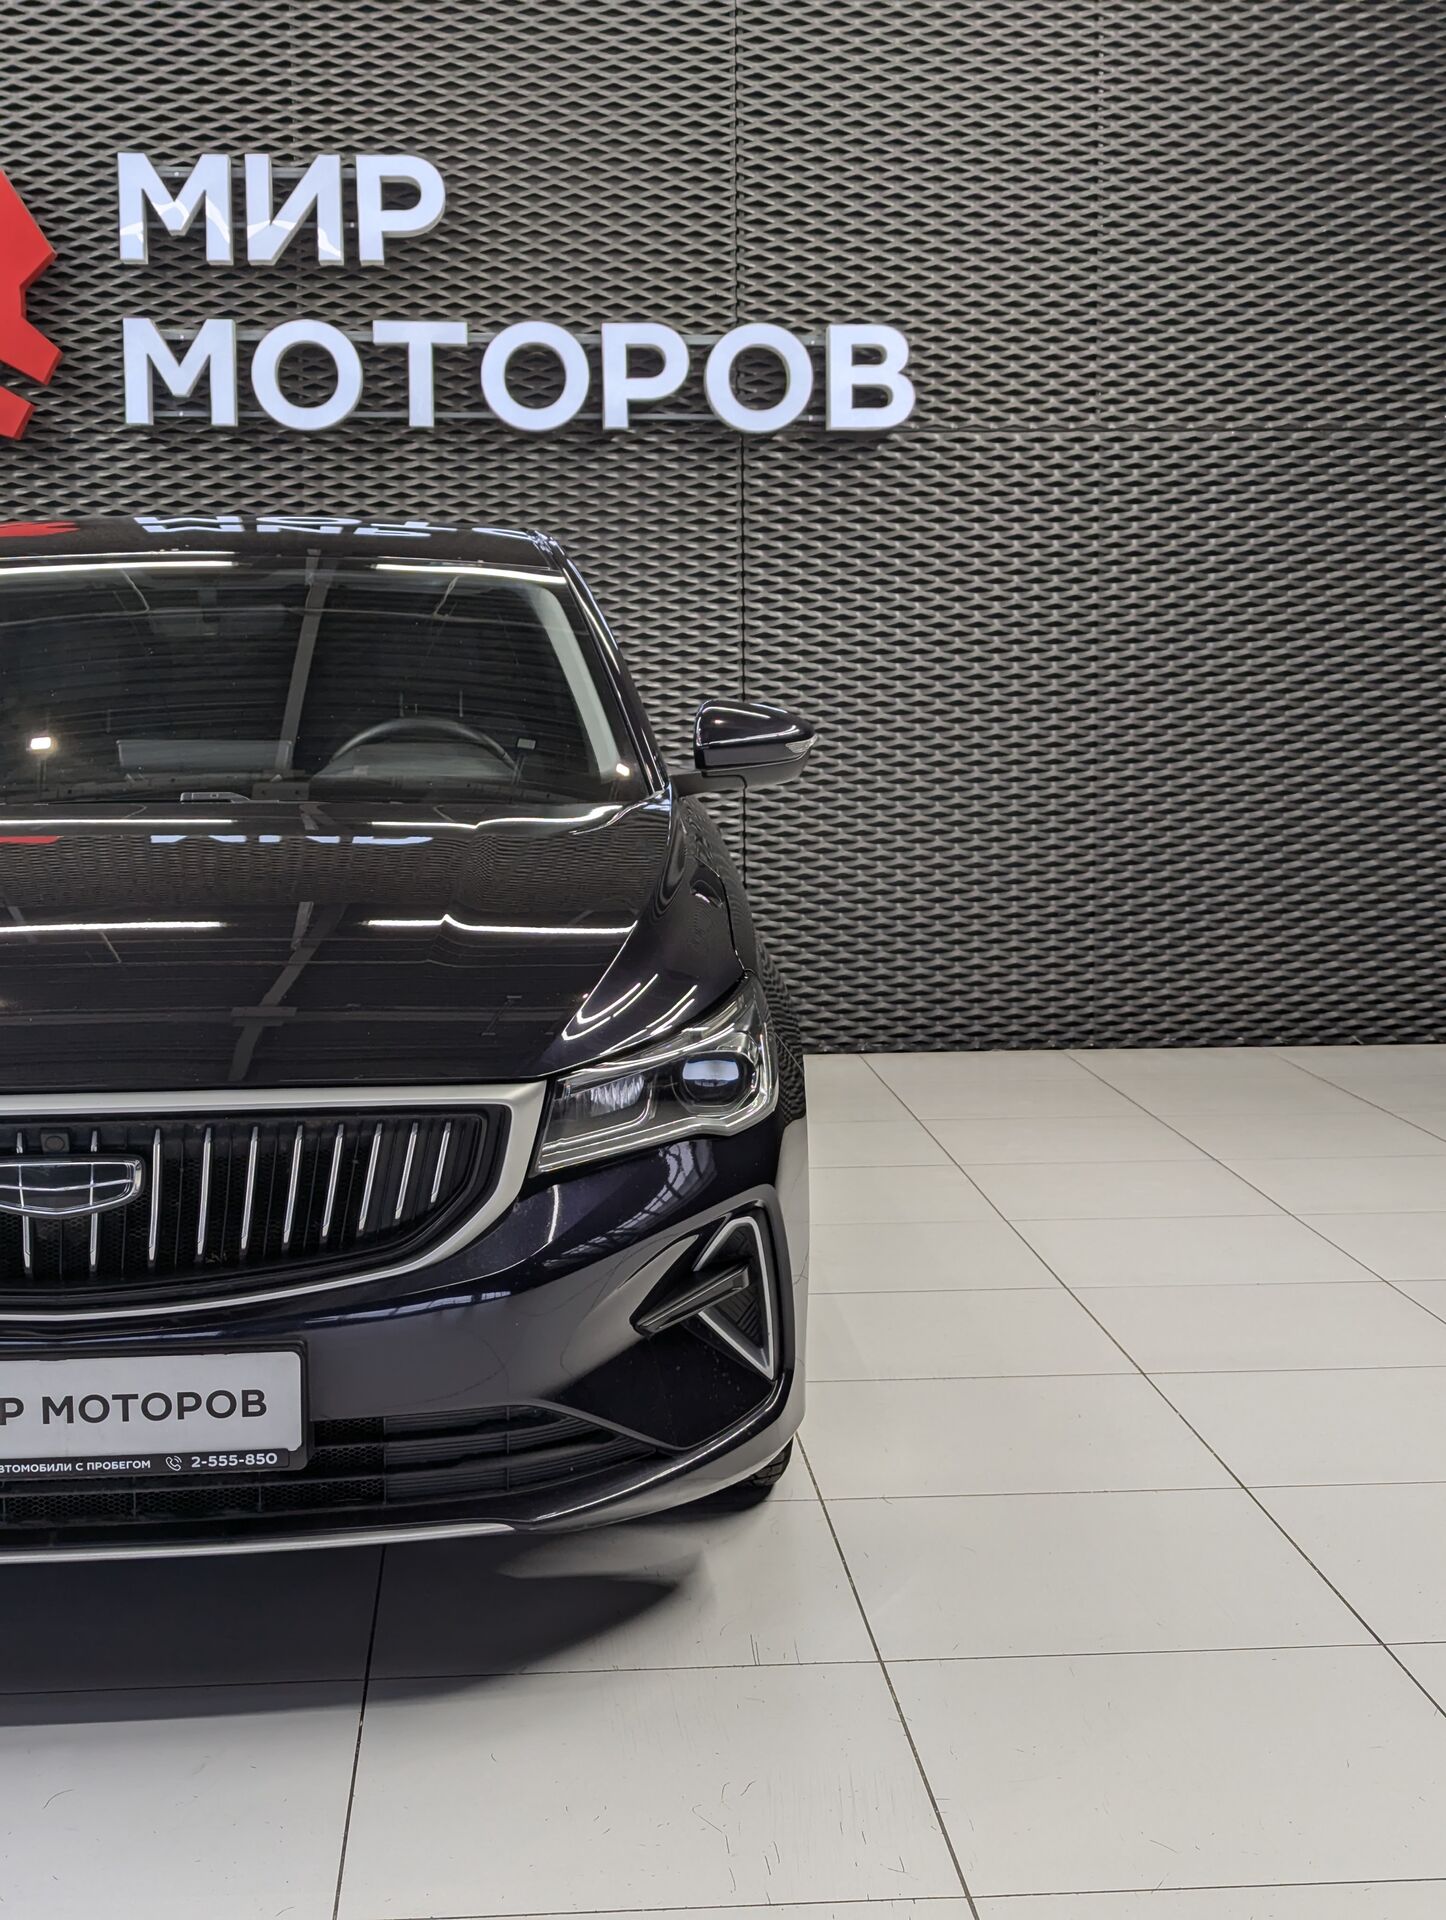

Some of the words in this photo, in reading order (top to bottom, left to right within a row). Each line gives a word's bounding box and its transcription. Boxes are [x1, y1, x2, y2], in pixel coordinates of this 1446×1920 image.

[116, 152, 447, 267] МИР
[122, 317, 917, 434] МОТОРОВ
[41, 1389, 268, 1425] МОТОРОВ
[75, 1462, 84, 1471] С
[86, 1459, 151, 1470] ПРОБЕГОМ
[190, 1452, 279, 1468] 2-555-850
